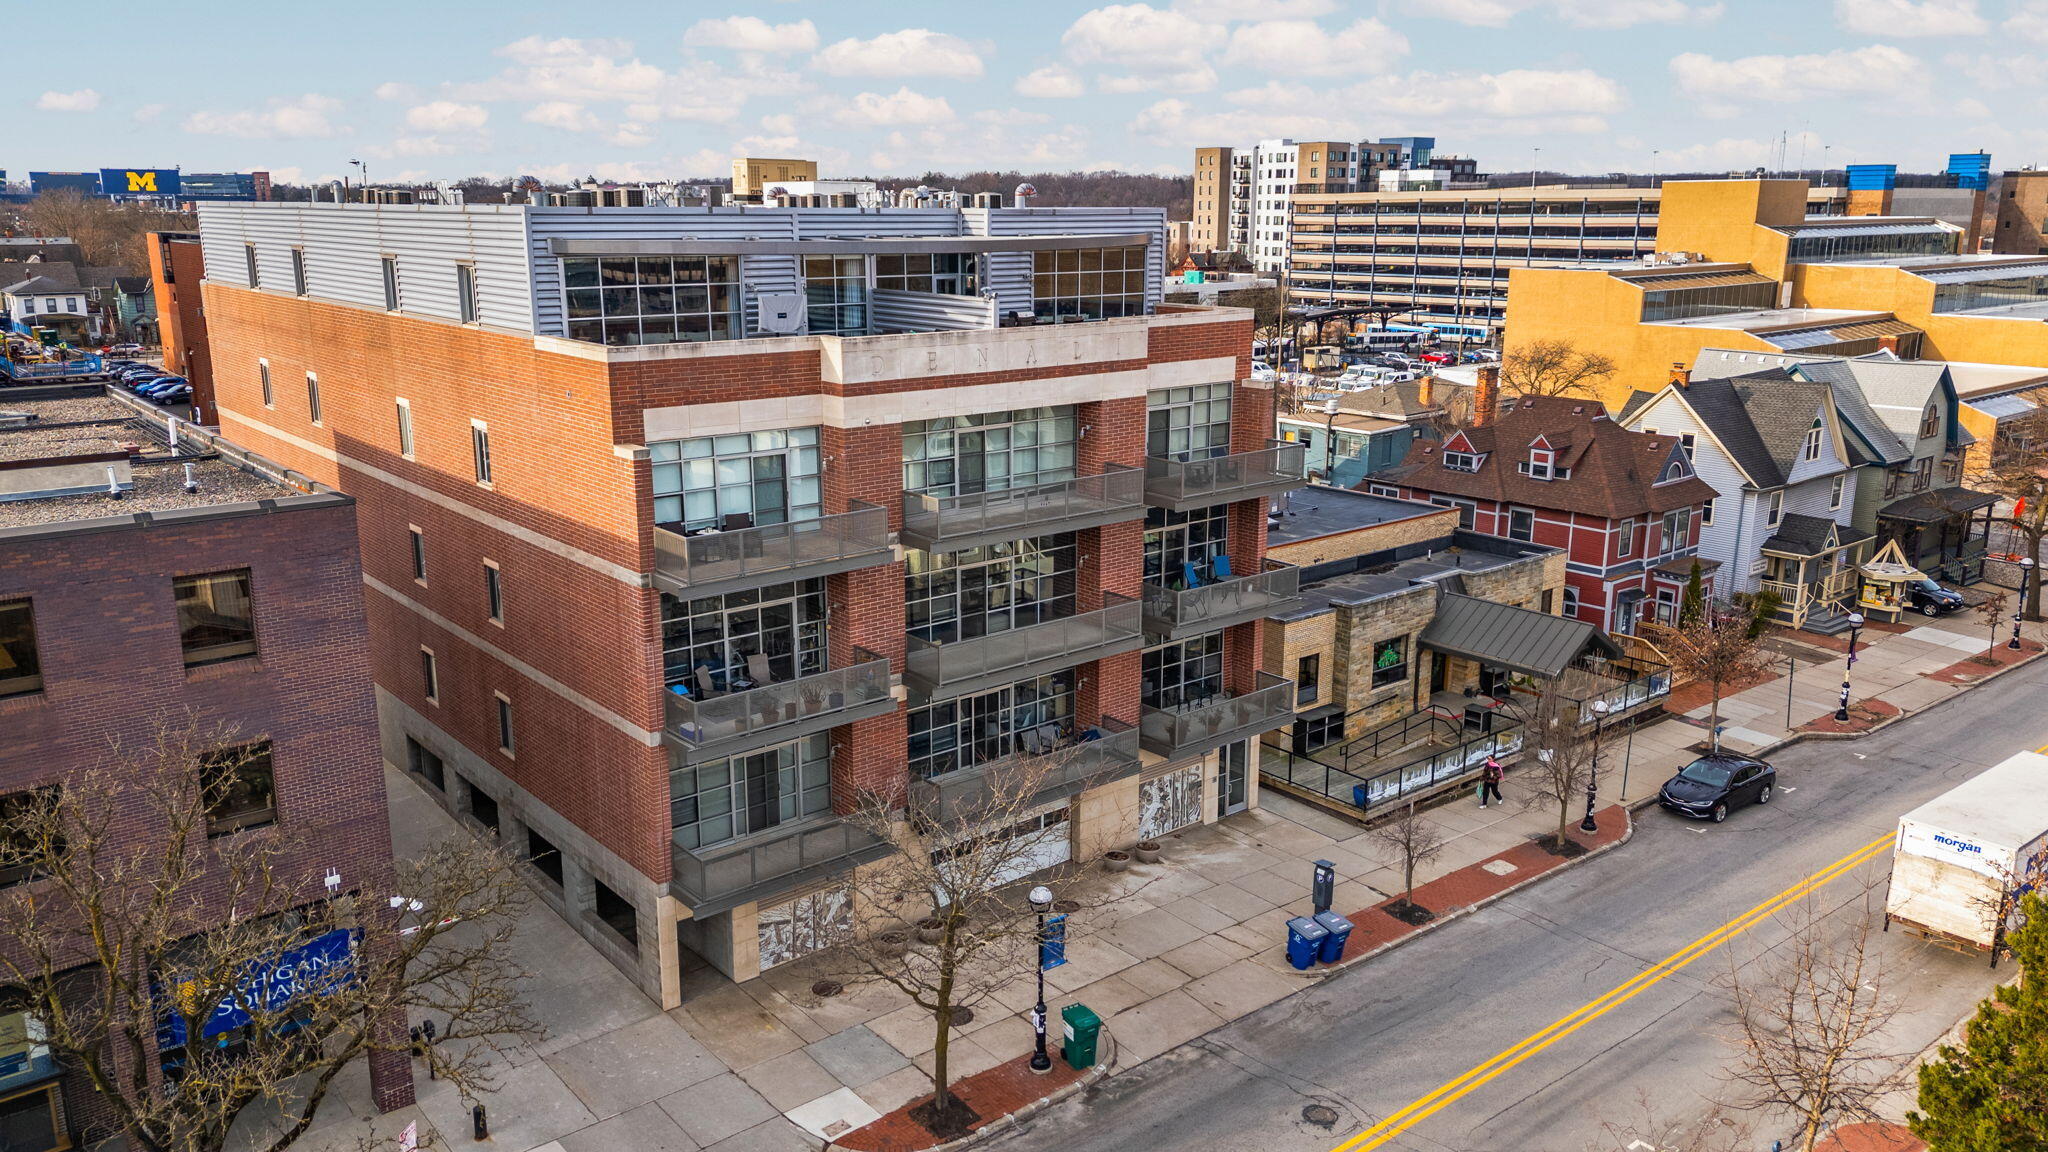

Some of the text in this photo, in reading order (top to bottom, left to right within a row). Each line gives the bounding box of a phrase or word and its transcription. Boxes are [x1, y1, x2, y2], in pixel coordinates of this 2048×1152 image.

[126, 171, 158, 192] M
[871, 337, 1121, 376] DENALI
[1933, 834, 1982, 853] morgan
